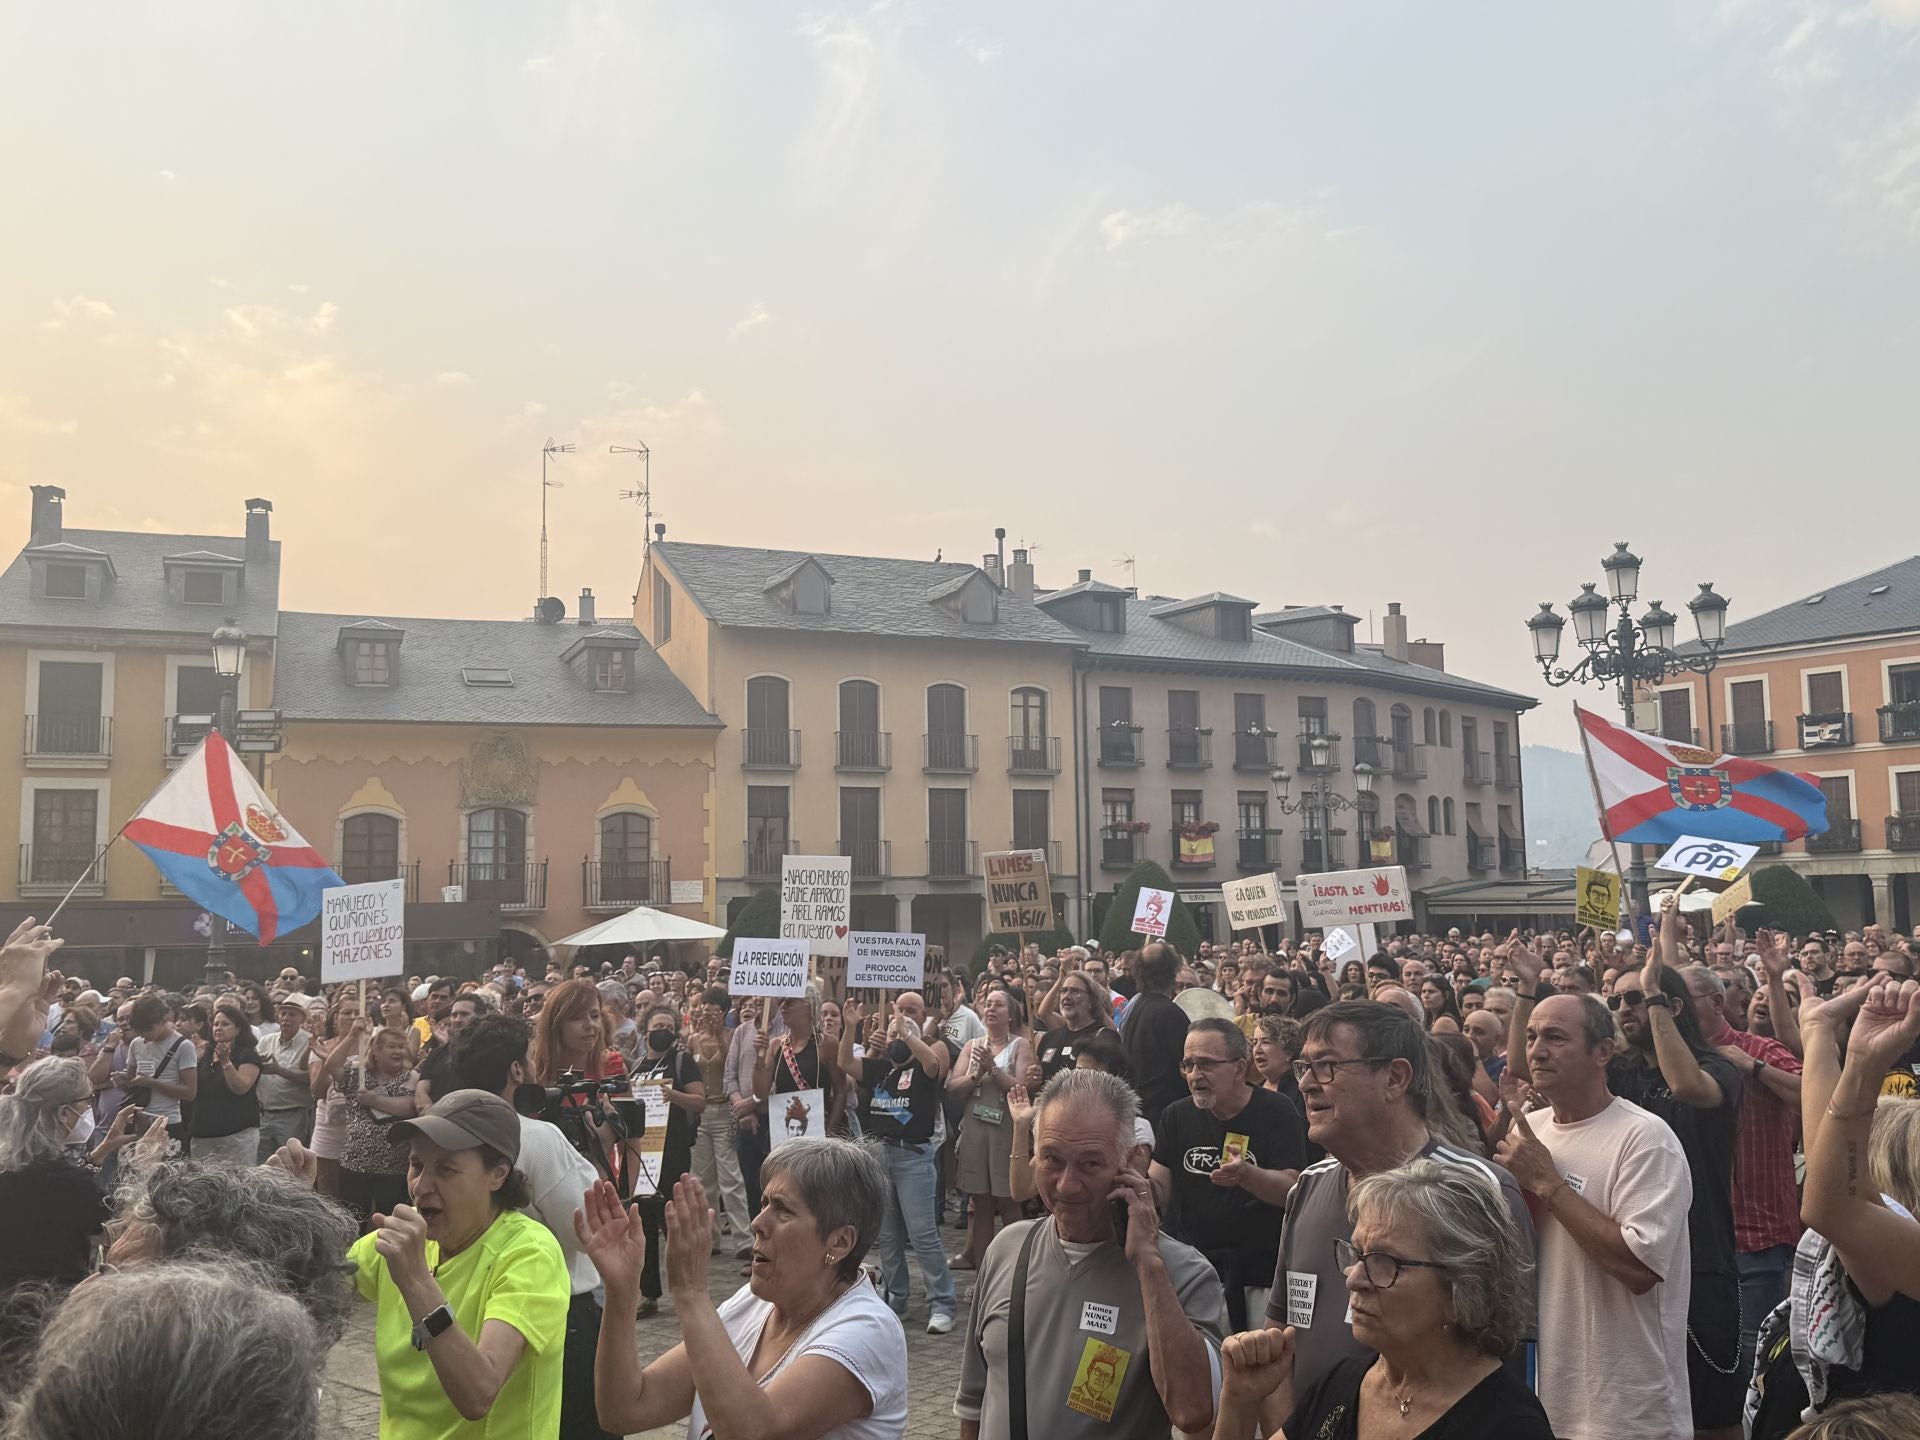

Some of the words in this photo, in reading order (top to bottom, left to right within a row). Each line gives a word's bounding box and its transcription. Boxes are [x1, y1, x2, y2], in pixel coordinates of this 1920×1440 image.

[989, 856, 1032, 876] LUMES
[788, 869, 816, 886] NACHO
[818, 869, 850, 887] RUMBAO
[784, 886, 809, 903] JAIME
[810, 887, 845, 904] APARICIO
[991, 881, 1038, 904] NUNCA
[1313, 885, 1348, 897] ¡BASTA
[1352, 885, 1365, 896] DE
[327, 894, 376, 914] MAÑUECO
[379, 892, 388, 908] Y
[1348, 900, 1405, 915] MENTIRAS!
[329, 908, 389, 931] QUIÑONES
[792, 904, 813, 921] ABEL
[815, 905, 846, 922] RAMOS
[1231, 910, 1245, 922] NOS
[326, 932, 350, 949] son
[353, 925, 404, 945] nuestros
[783, 922, 795, 938] en
[798, 923, 833, 940] nuestro
[854, 936, 894, 946] VUESTRA
[895, 937, 921, 946] FALTA
[332, 942, 392, 966] MAZONES
[738, 951, 749, 965] LA
[750, 948, 804, 967] PREVENCIÓN
[857, 948, 868, 956] DE
[870, 948, 917, 958] INVERSIÓN
[865, 963, 907, 972] PROVOCA
[734, 970, 746, 985] ES
[747, 971, 758, 986] LA
[759, 969, 803, 987] SOLUCIÓN
[855, 973, 916, 983] DESTRUCCIÓN
[1085, 1311, 1112, 1322] NUNCA
[1088, 1303, 1112, 1315] Lumes
